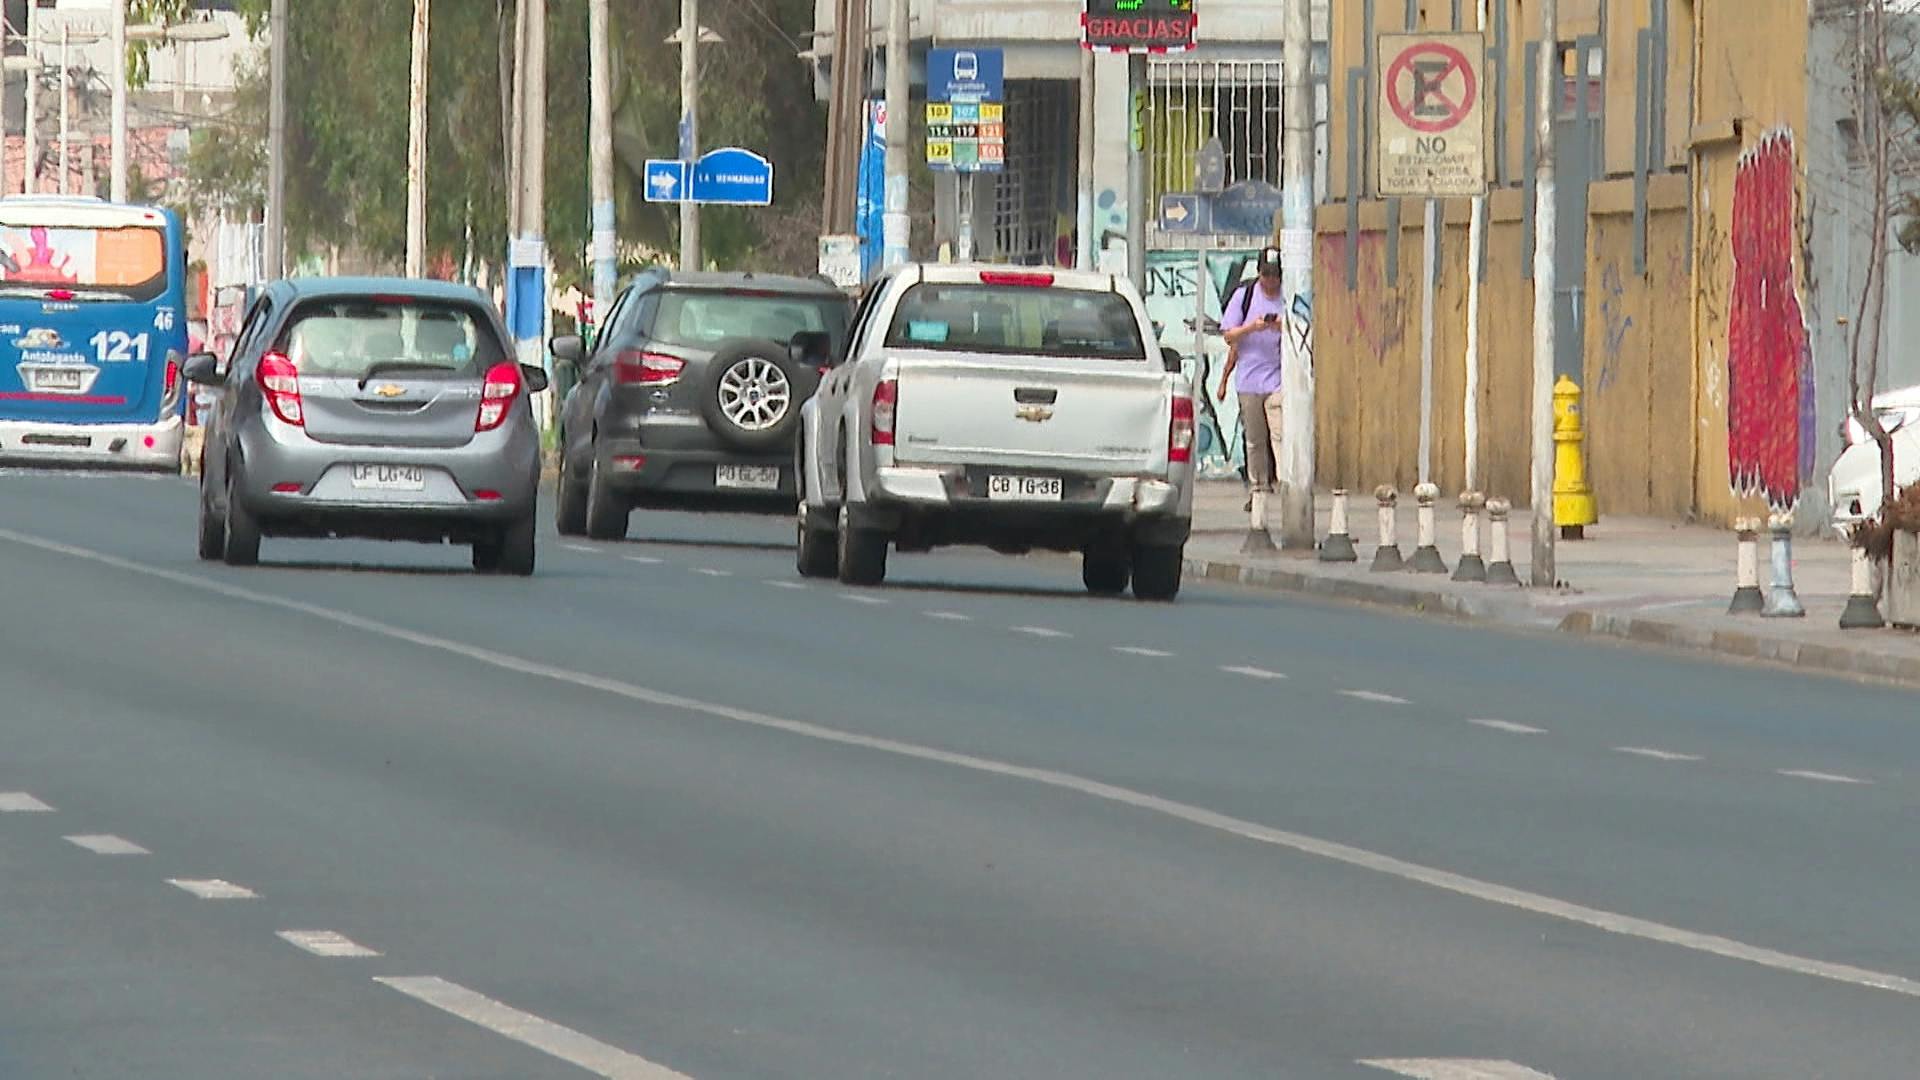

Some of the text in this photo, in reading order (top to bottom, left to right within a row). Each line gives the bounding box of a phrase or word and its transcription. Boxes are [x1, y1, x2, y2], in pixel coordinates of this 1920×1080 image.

[929, 126, 950, 137] 114
[956, 126, 976, 137] 119
[931, 144, 949, 156] 129
[1416, 136, 1447, 154] NO
[153, 311, 174, 331] 46
[90, 331, 149, 363] 121
